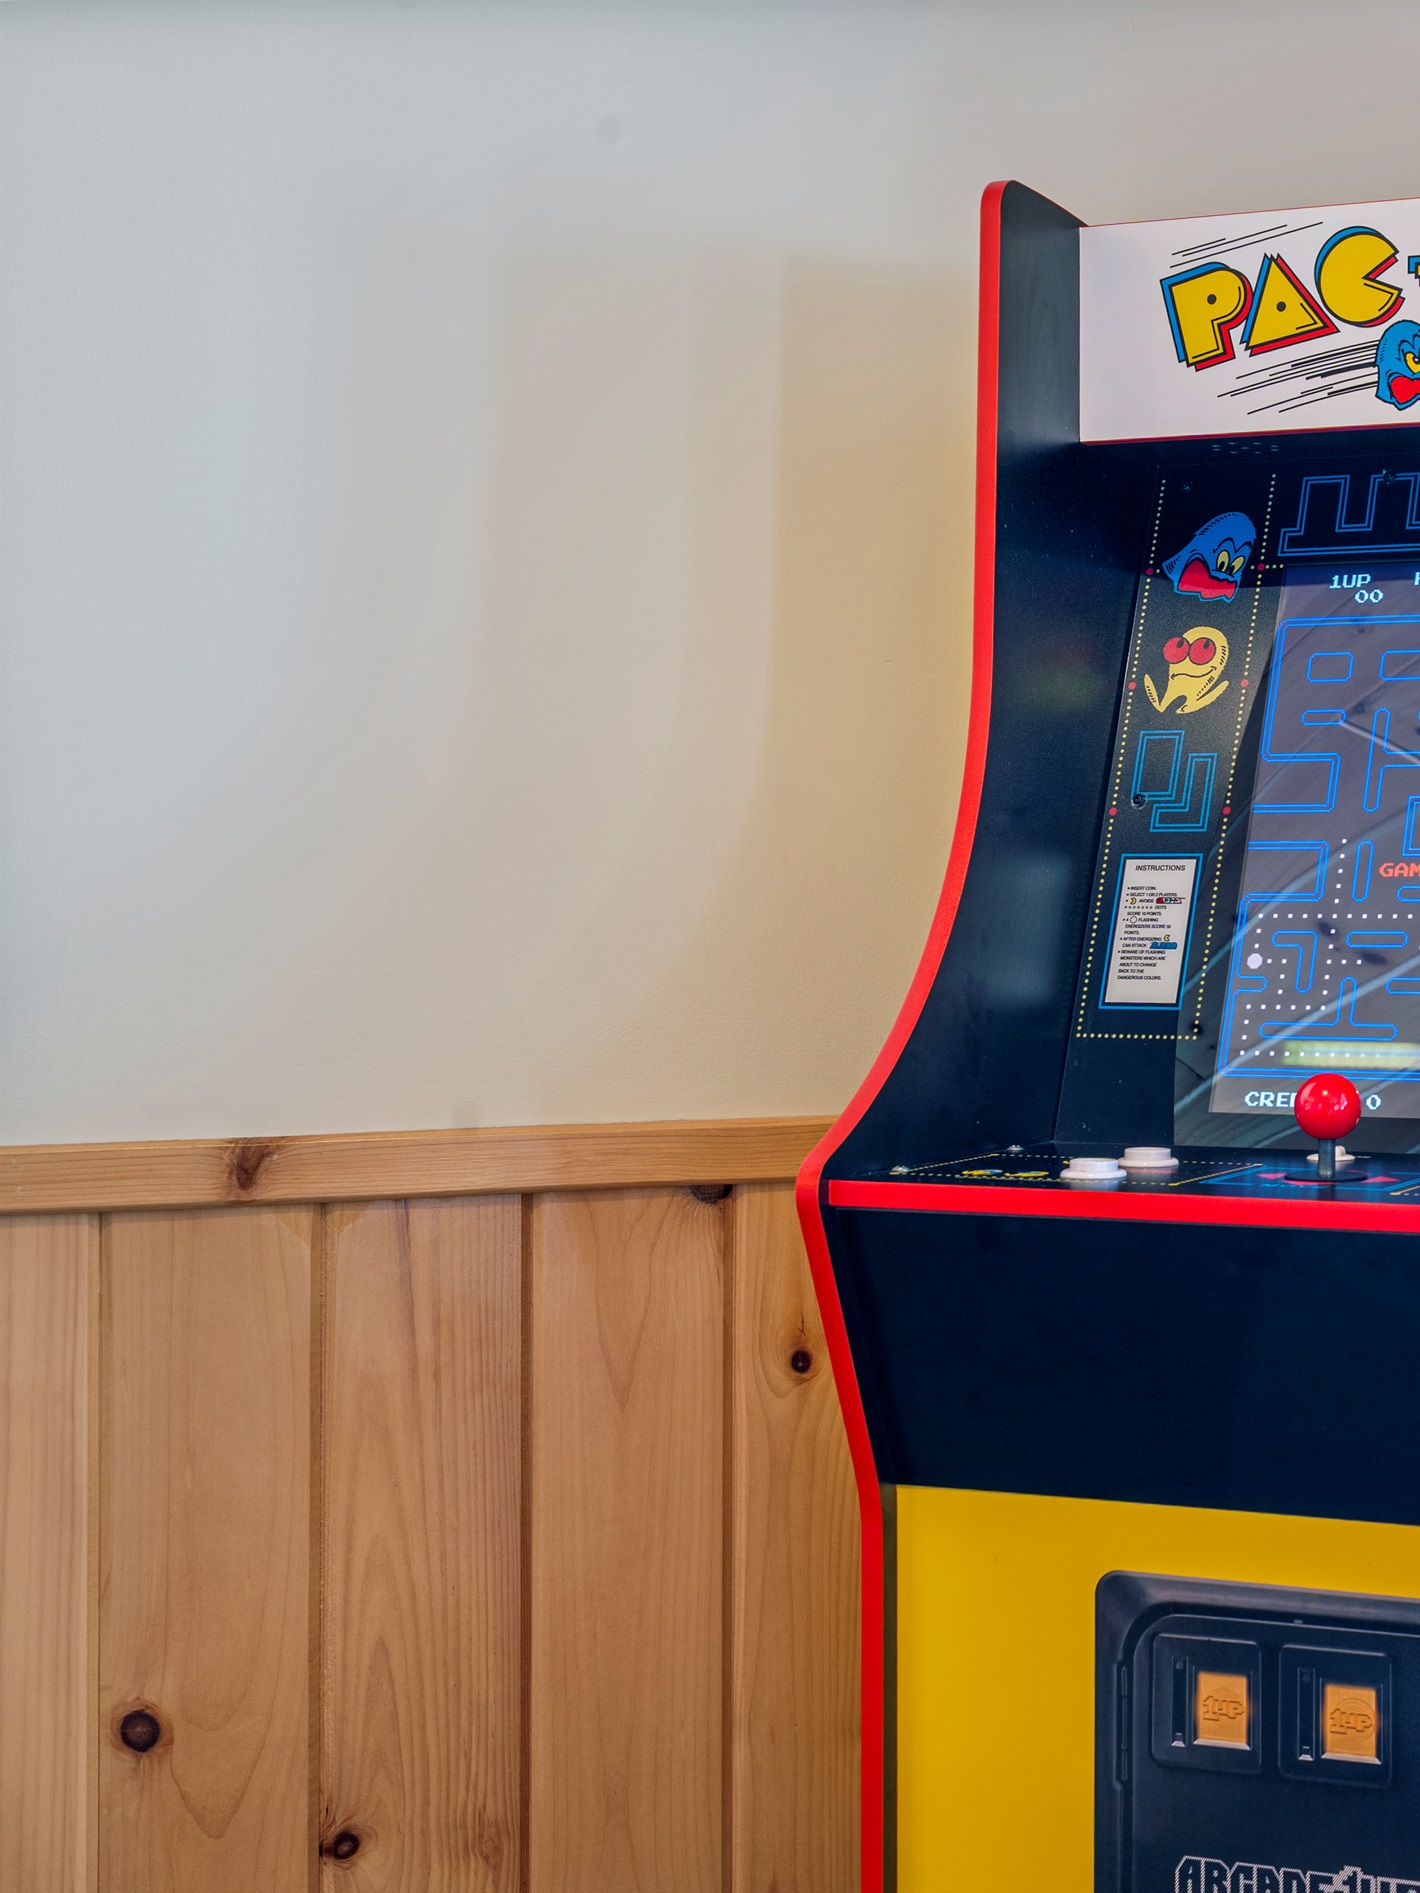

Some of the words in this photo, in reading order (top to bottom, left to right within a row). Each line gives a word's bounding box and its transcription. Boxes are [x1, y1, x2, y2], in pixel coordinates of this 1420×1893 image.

[1329, 574, 1371, 589] 1UP
[1354, 589, 1384, 603] 00
[1244, 1091, 1296, 1108] CRE
